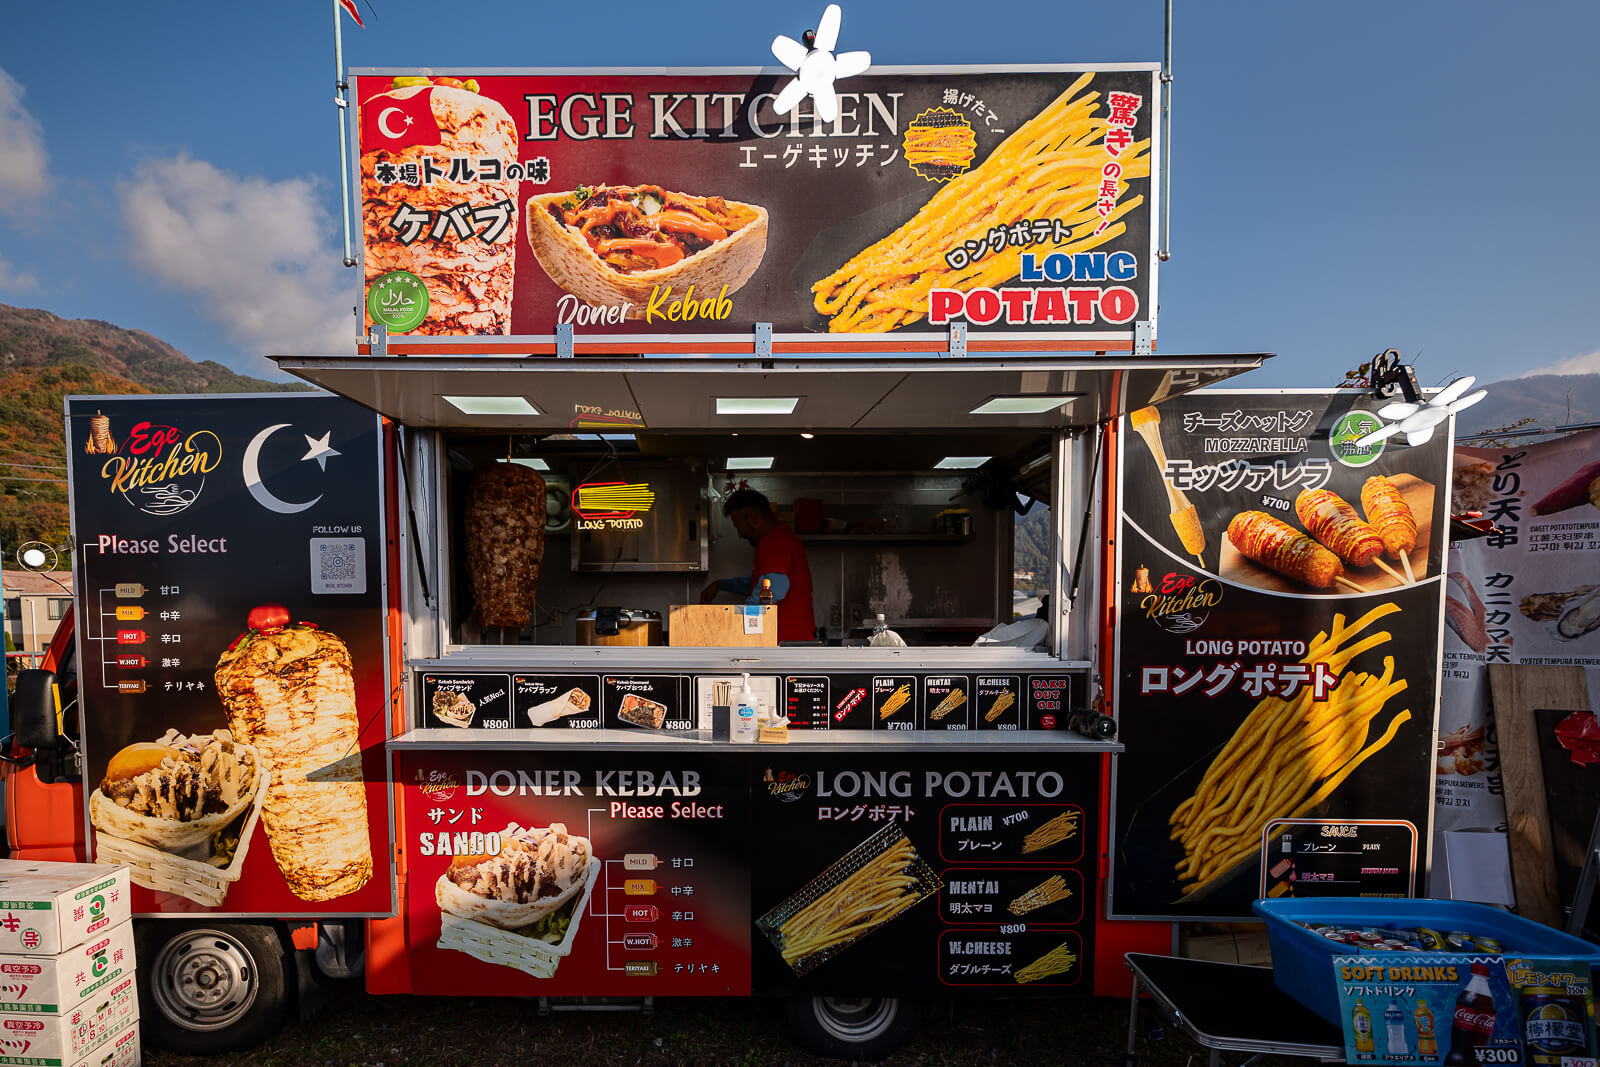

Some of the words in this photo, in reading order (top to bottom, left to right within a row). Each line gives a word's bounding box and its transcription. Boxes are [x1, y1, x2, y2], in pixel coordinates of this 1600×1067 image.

[524, 93, 636, 141] EGE
[648, 92, 904, 141] KITCHEN
[739, 144, 900, 168] エーゲキッチン
[375, 156, 551, 187] 本場トルコの味
[389, 200, 515, 246] ケバブ
[945, 218, 1072, 270] ロングポテト
[1020, 251, 1138, 282] LONG
[381, 289, 415, 306] حلال
[556, 294, 634, 326] Doner
[646, 283, 733, 325] Kebab
[929, 286, 1139, 325] POTATO
[1184, 409, 1312, 433] チーズハットグ
[1340, 419, 1374, 436] 人気
[130, 421, 179, 457] Ege
[1204, 438, 1309, 453] MOZZARELLA
[101, 430, 222, 494] Kitchen
[1164, 458, 1332, 491] モッツァレラ
[1262, 494, 1290, 511] ¥700
[312, 526, 349, 534] FOLLOW
[577, 519, 605, 530] LONG
[605, 518, 644, 529] POTATO
[1529, 524, 1549, 532] SWEET
[98, 535, 160, 554] Please
[168, 534, 228, 553] Select
[1529, 543, 1560, 552] 고구마
[1563, 541, 1584, 550] 튀김
[1161, 572, 1195, 595] Ege
[160, 585, 180, 595] 甘口
[1140, 579, 1223, 619] Kitchen
[160, 610, 181, 621] 中辛
[161, 634, 181, 643] 辛口
[1185, 639, 1234, 655] LONG
[1237, 640, 1306, 656] POTATO
[162, 658, 181, 668] 激辛
[1459, 653, 1486, 662] TEMPURA
[1520, 657, 1543, 665] OYSTER
[164, 681, 205, 691] テリヤキ
[437, 684, 473, 692] ケバブサンド
[875, 679, 894, 687] PLAIN
[927, 678, 951, 686] MENTAI
[979, 678, 1010, 686] W.CHEESE
[1032, 680, 1067, 689] TAKE
[1141, 662, 1339, 702] ロングポテト
[518, 686, 558, 694] ケバブラップ
[1033, 690, 1060, 699] OUT
[835, 689, 866, 721] ロングポテト
[1037, 700, 1061, 710] OK!
[482, 719, 509, 729] ¥800
[569, 719, 599, 729] ¥1000
[665, 720, 692, 730] ¥800
[887, 722, 914, 731] ¥700
[419, 775, 460, 795] Kitchen
[465, 769, 585, 797] DONER
[595, 770, 702, 797] KEBAB
[768, 774, 811, 795] Kitchen
[816, 771, 913, 798] LONG
[924, 771, 1064, 798] POTATO
[1460, 781, 1485, 789] SKEWERS
[610, 802, 664, 819] Please
[670, 801, 724, 819] Select
[818, 804, 916, 822] ロングポテト
[427, 807, 485, 826] サンド
[1002, 810, 1029, 827] ¥700
[950, 815, 993, 832] PLAIN
[1320, 826, 1358, 838] SAUCE
[419, 831, 502, 857] SANDO
[957, 840, 1003, 851] プレーン
[1303, 843, 1337, 852] プレーン
[629, 858, 648, 866] MILD
[671, 857, 694, 868] 甘口
[1301, 872, 1335, 881] 明太マヨ
[631, 883, 645, 891] MIX
[671, 885, 695, 897] 中辛
[949, 880, 999, 895] MENTAI
[632, 909, 649, 917] HOT
[949, 903, 993, 915] 明太マヨ
[671, 910, 694, 921] 辛口
[1000, 923, 1026, 935] ¥800
[671, 937, 693, 948] 激辛
[949, 941, 1012, 956] W.CHEESE
[673, 963, 720, 974] テリヤキ
[949, 964, 1012, 975] ダブルチーズ
[1341, 966, 1386, 982] SOFT
[1388, 966, 1460, 982] DRINKS
[1512, 971, 1590, 986] レモンサワー
[1343, 986, 1416, 997] ソフトドリンク
[1474, 1048, 1518, 1063] ¥300
